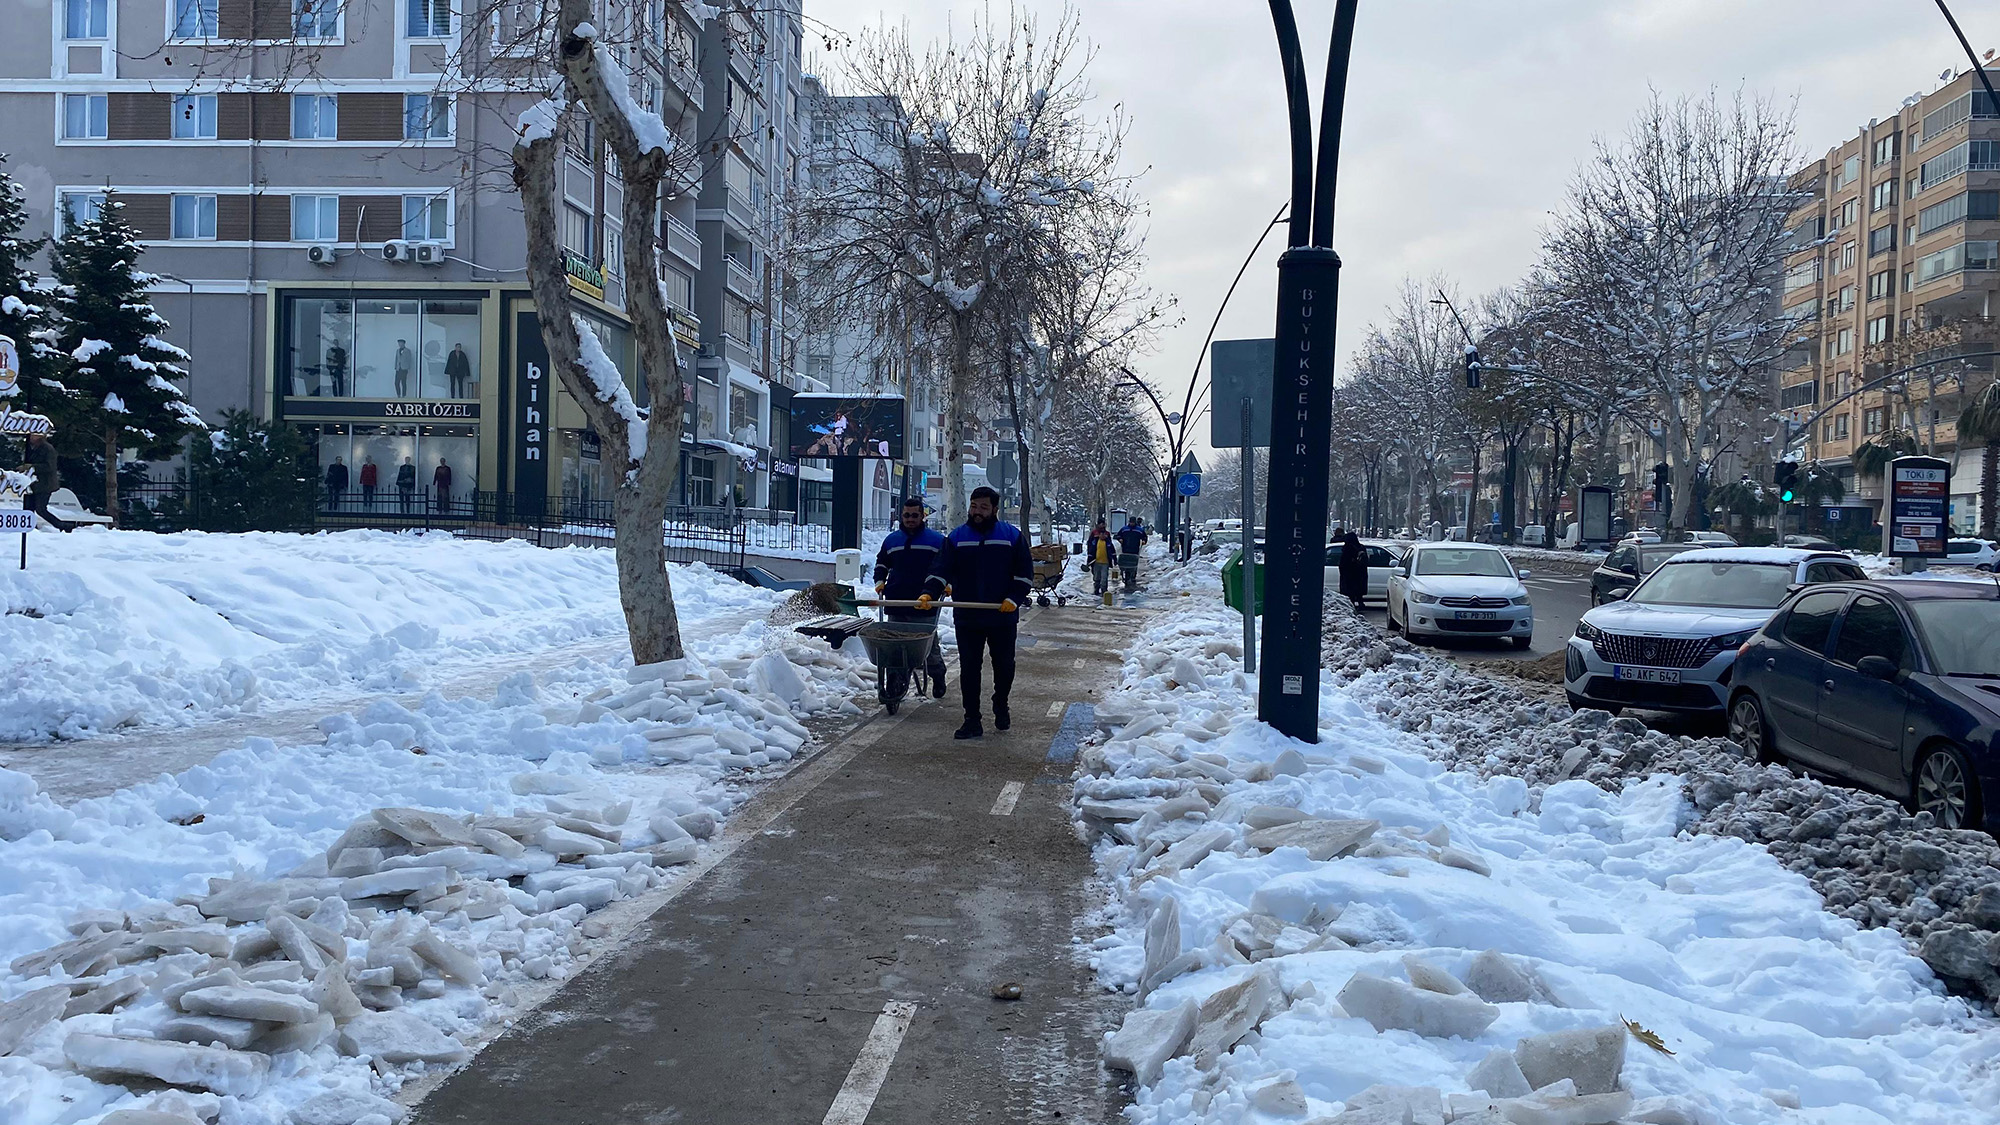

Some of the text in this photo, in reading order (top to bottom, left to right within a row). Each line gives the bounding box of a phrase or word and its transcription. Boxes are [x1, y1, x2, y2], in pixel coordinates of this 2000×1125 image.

[385, 402, 471, 417] SABRİ ÖZEL
[526, 362, 541, 460] bihan
[774, 459, 797, 475] atanur
[6, 514, 18, 528] 80
[20, 514, 32, 528] 81
[1620, 668, 1678, 682] 46 AKF 642
